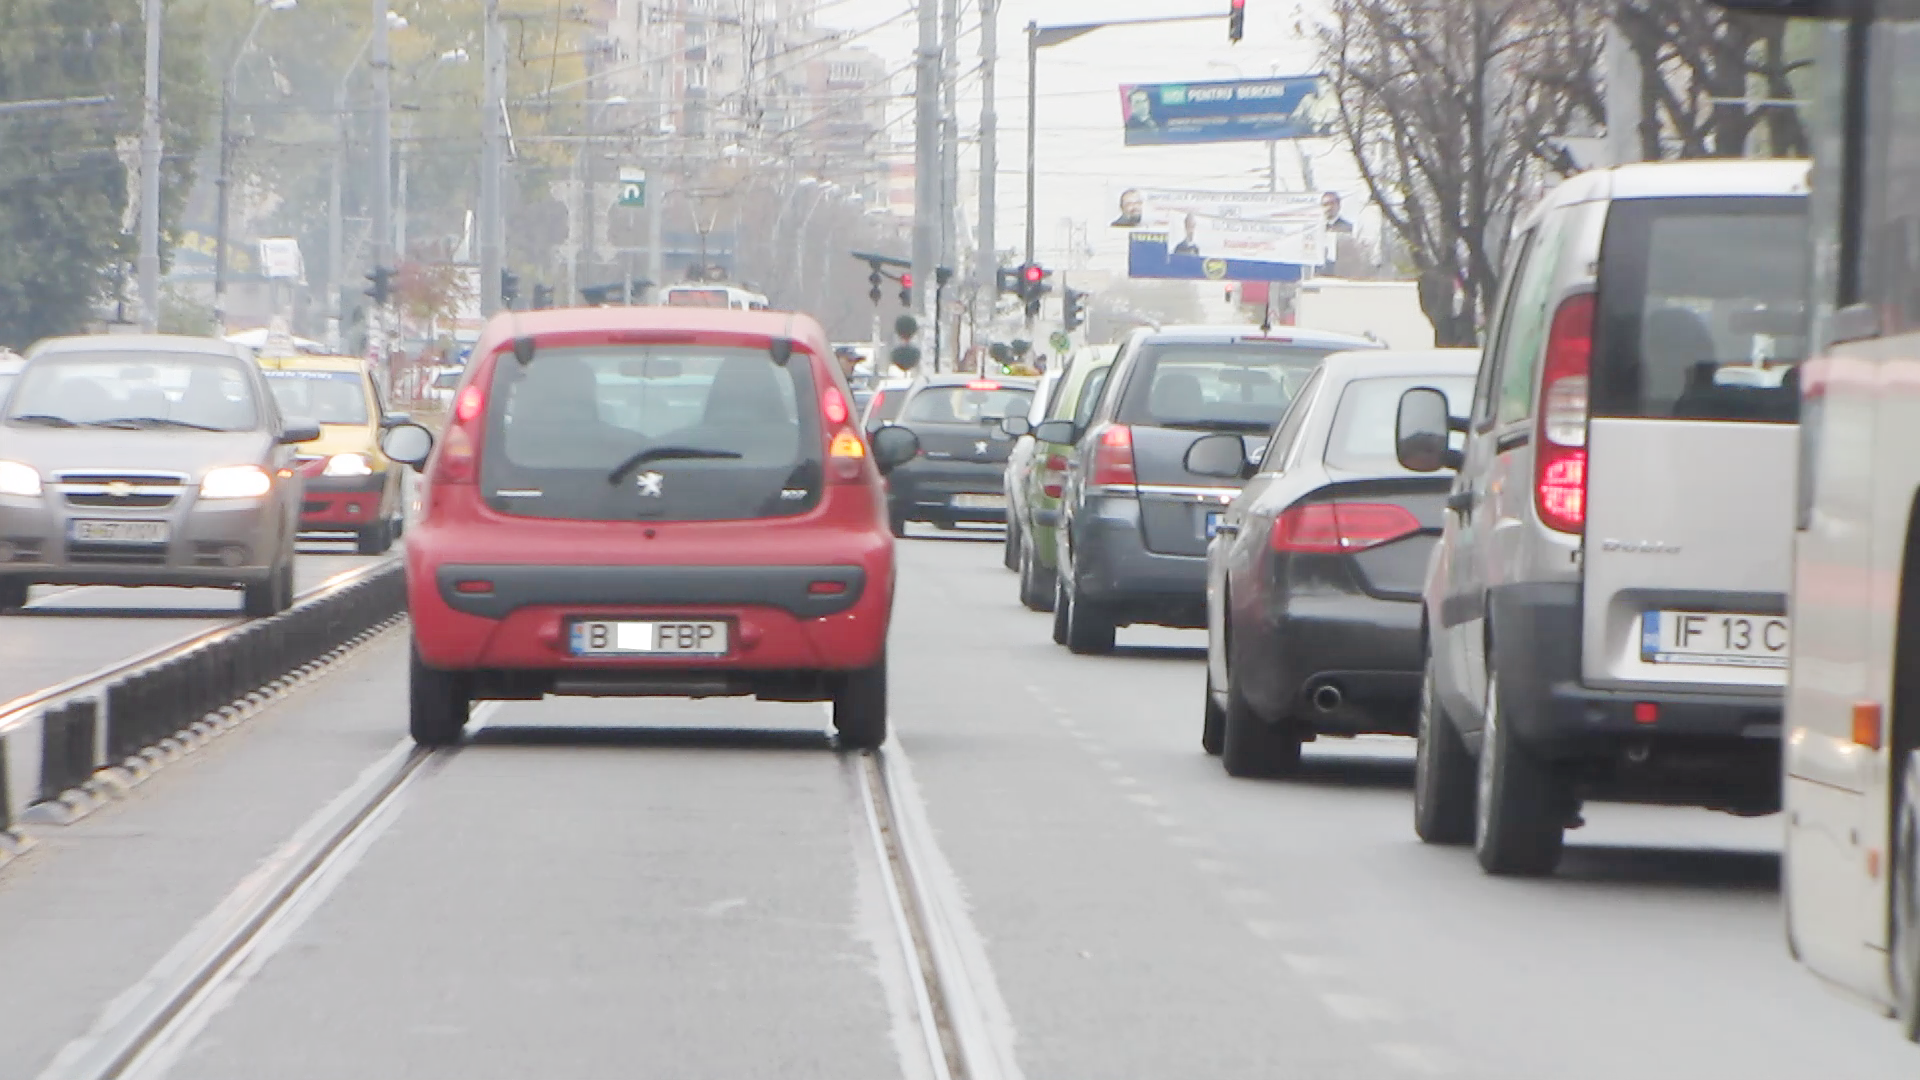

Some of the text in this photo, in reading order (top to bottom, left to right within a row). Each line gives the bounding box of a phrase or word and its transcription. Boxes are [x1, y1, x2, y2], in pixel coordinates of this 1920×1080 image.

[1188, 87, 1234, 103] PENTRU
[590, 623, 715, 650] B FBP
[1675, 615, 1788, 652] IF 13 C
